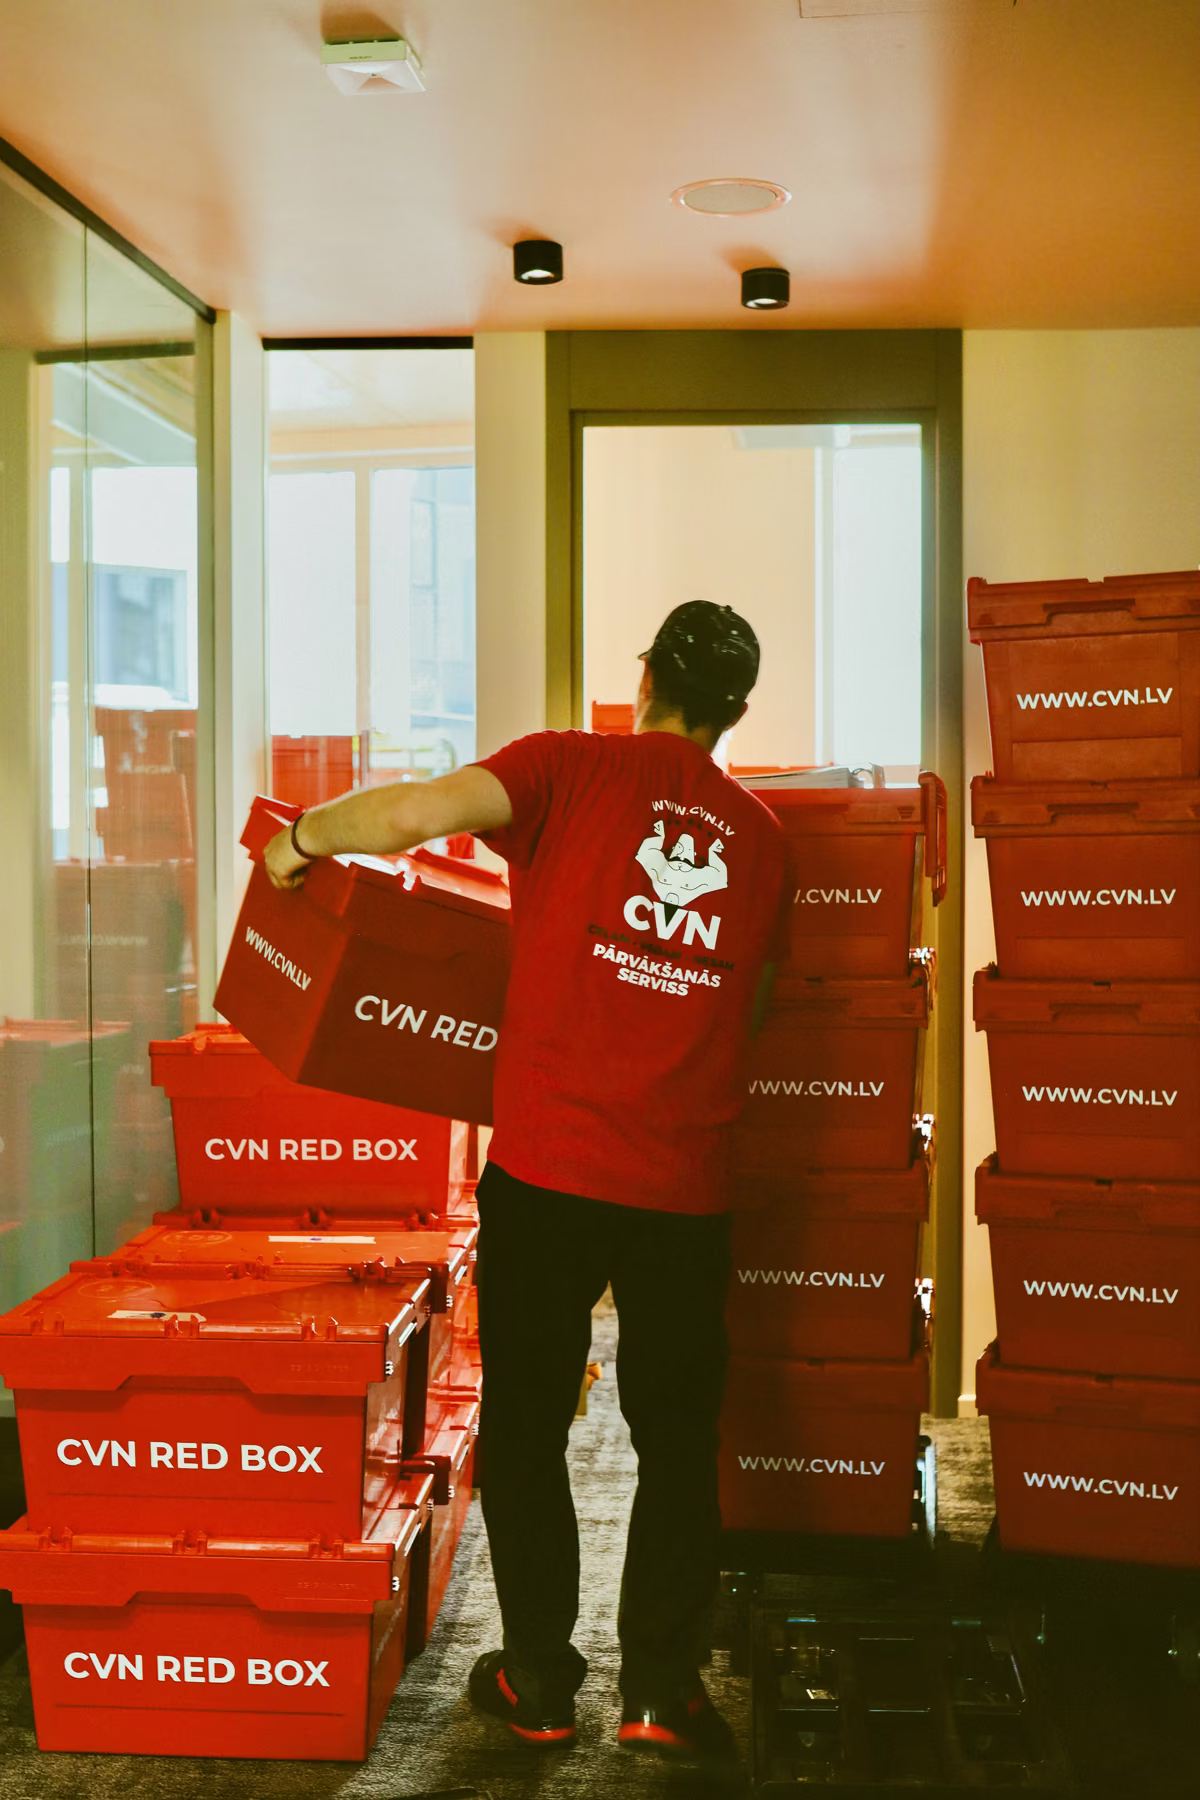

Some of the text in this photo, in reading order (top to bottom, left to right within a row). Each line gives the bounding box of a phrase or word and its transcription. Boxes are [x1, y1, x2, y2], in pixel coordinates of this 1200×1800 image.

[1016, 686, 1173, 711] WWW.CVN.LV
[794, 888, 882, 904] .CVN.LV
[1020, 887, 1177, 907] WWW.CVN.LV
[623, 895, 721, 950] CVN
[245, 926, 312, 991] WWW.CVN.LV
[592, 943, 722, 988] PĀRVĀKŠANĀS
[616, 967, 690, 997] SERVISS
[354, 995, 499, 1051] CVN RED
[1021, 1085, 1178, 1107] WWW.CVN.LV
[204, 1137, 419, 1162] CVN RED BOX
[737, 1269, 886, 1289] WWW.CVN.LV
[1023, 1279, 1179, 1305] WWW.CVN.LV
[56, 1438, 324, 1474] CVN RED BOX
[737, 1455, 886, 1476] WWW.CVN.LV
[1023, 1471, 1179, 1501] WWW.CVN.LV
[63, 1651, 331, 1687] CVN RED BOX
